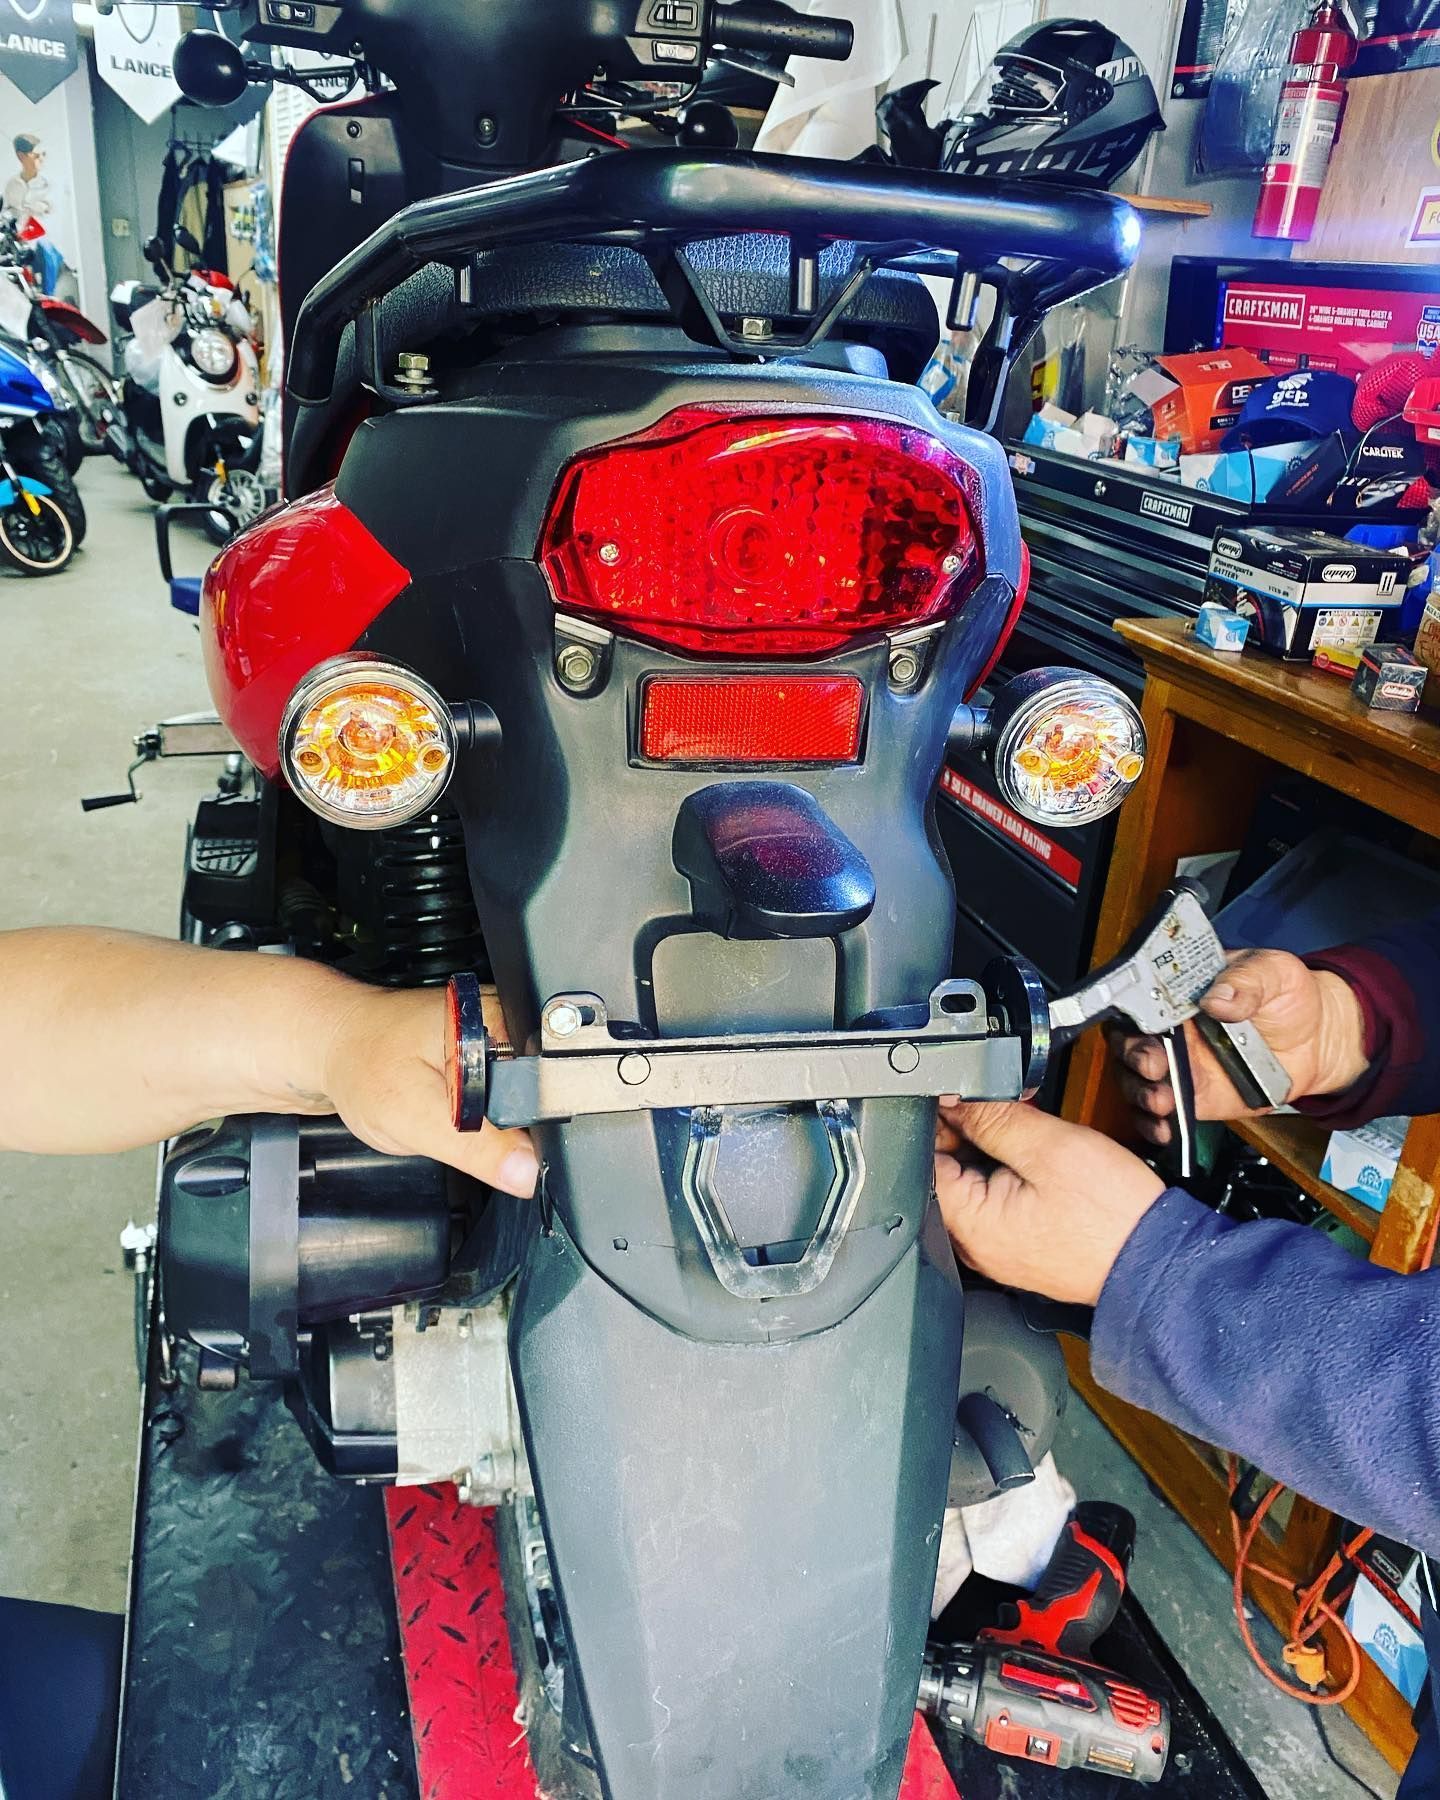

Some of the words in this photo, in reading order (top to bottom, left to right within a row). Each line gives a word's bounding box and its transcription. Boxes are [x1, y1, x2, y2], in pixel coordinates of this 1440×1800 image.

[110, 55, 173, 79] LANCE
[1229, 298, 1299, 320] CRAFTSMAN
[1272, 390, 1308, 404] gcp
[1143, 497, 1189, 521] CRAFTSMAN
[1214, 566, 1240, 580] BATTERY
[972, 791, 1003, 824] DRAWER
[1002, 812, 1022, 839] LOAD
[1022, 827, 1051, 860] RATING
